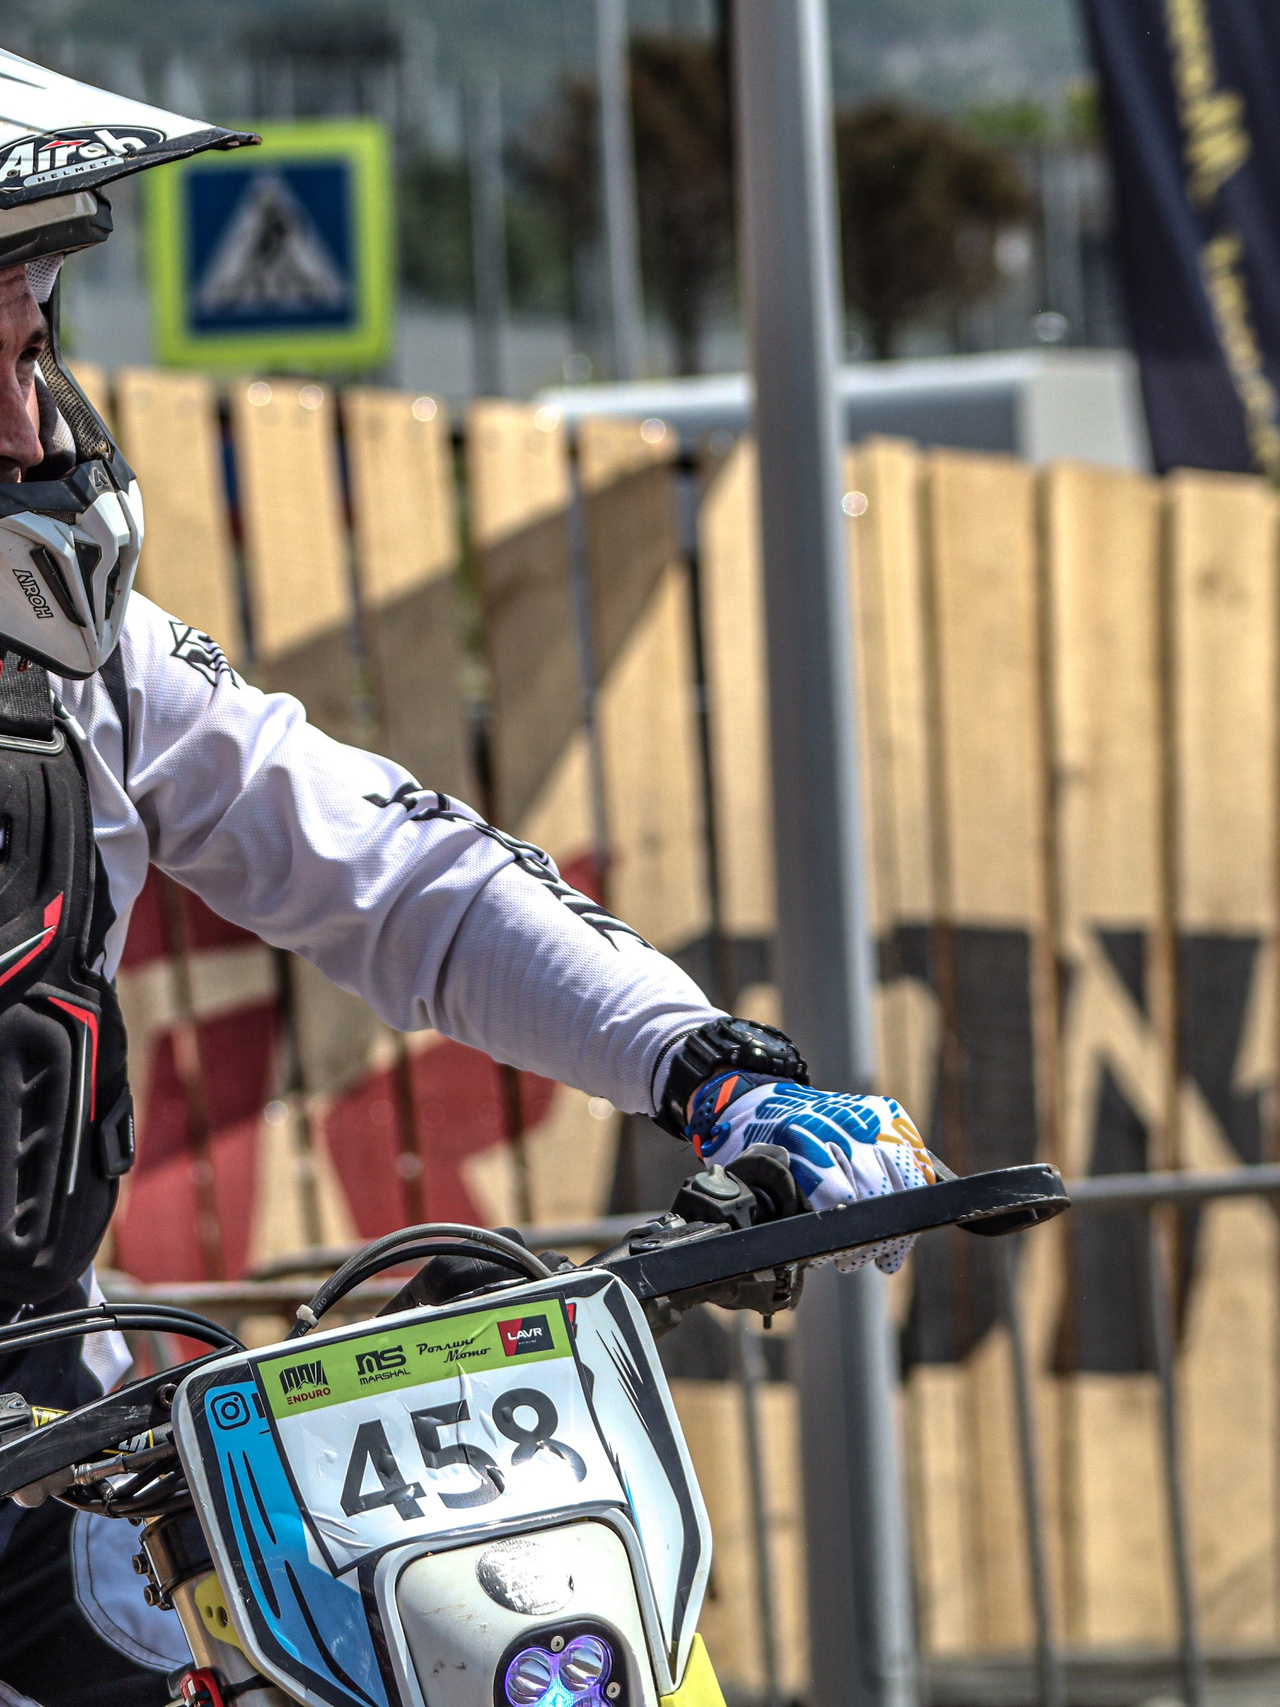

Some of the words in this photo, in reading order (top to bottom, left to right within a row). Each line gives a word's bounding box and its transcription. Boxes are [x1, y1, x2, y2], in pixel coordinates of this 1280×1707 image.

[37, 160, 109, 183] HELMET
[12, 568, 54, 620] AIROH
[507, 1327, 544, 1341] LAVR
[360, 1368, 411, 1386] MARSHAL
[286, 1387, 332, 1406] ENDURO
[340, 1387, 588, 1521] 458
